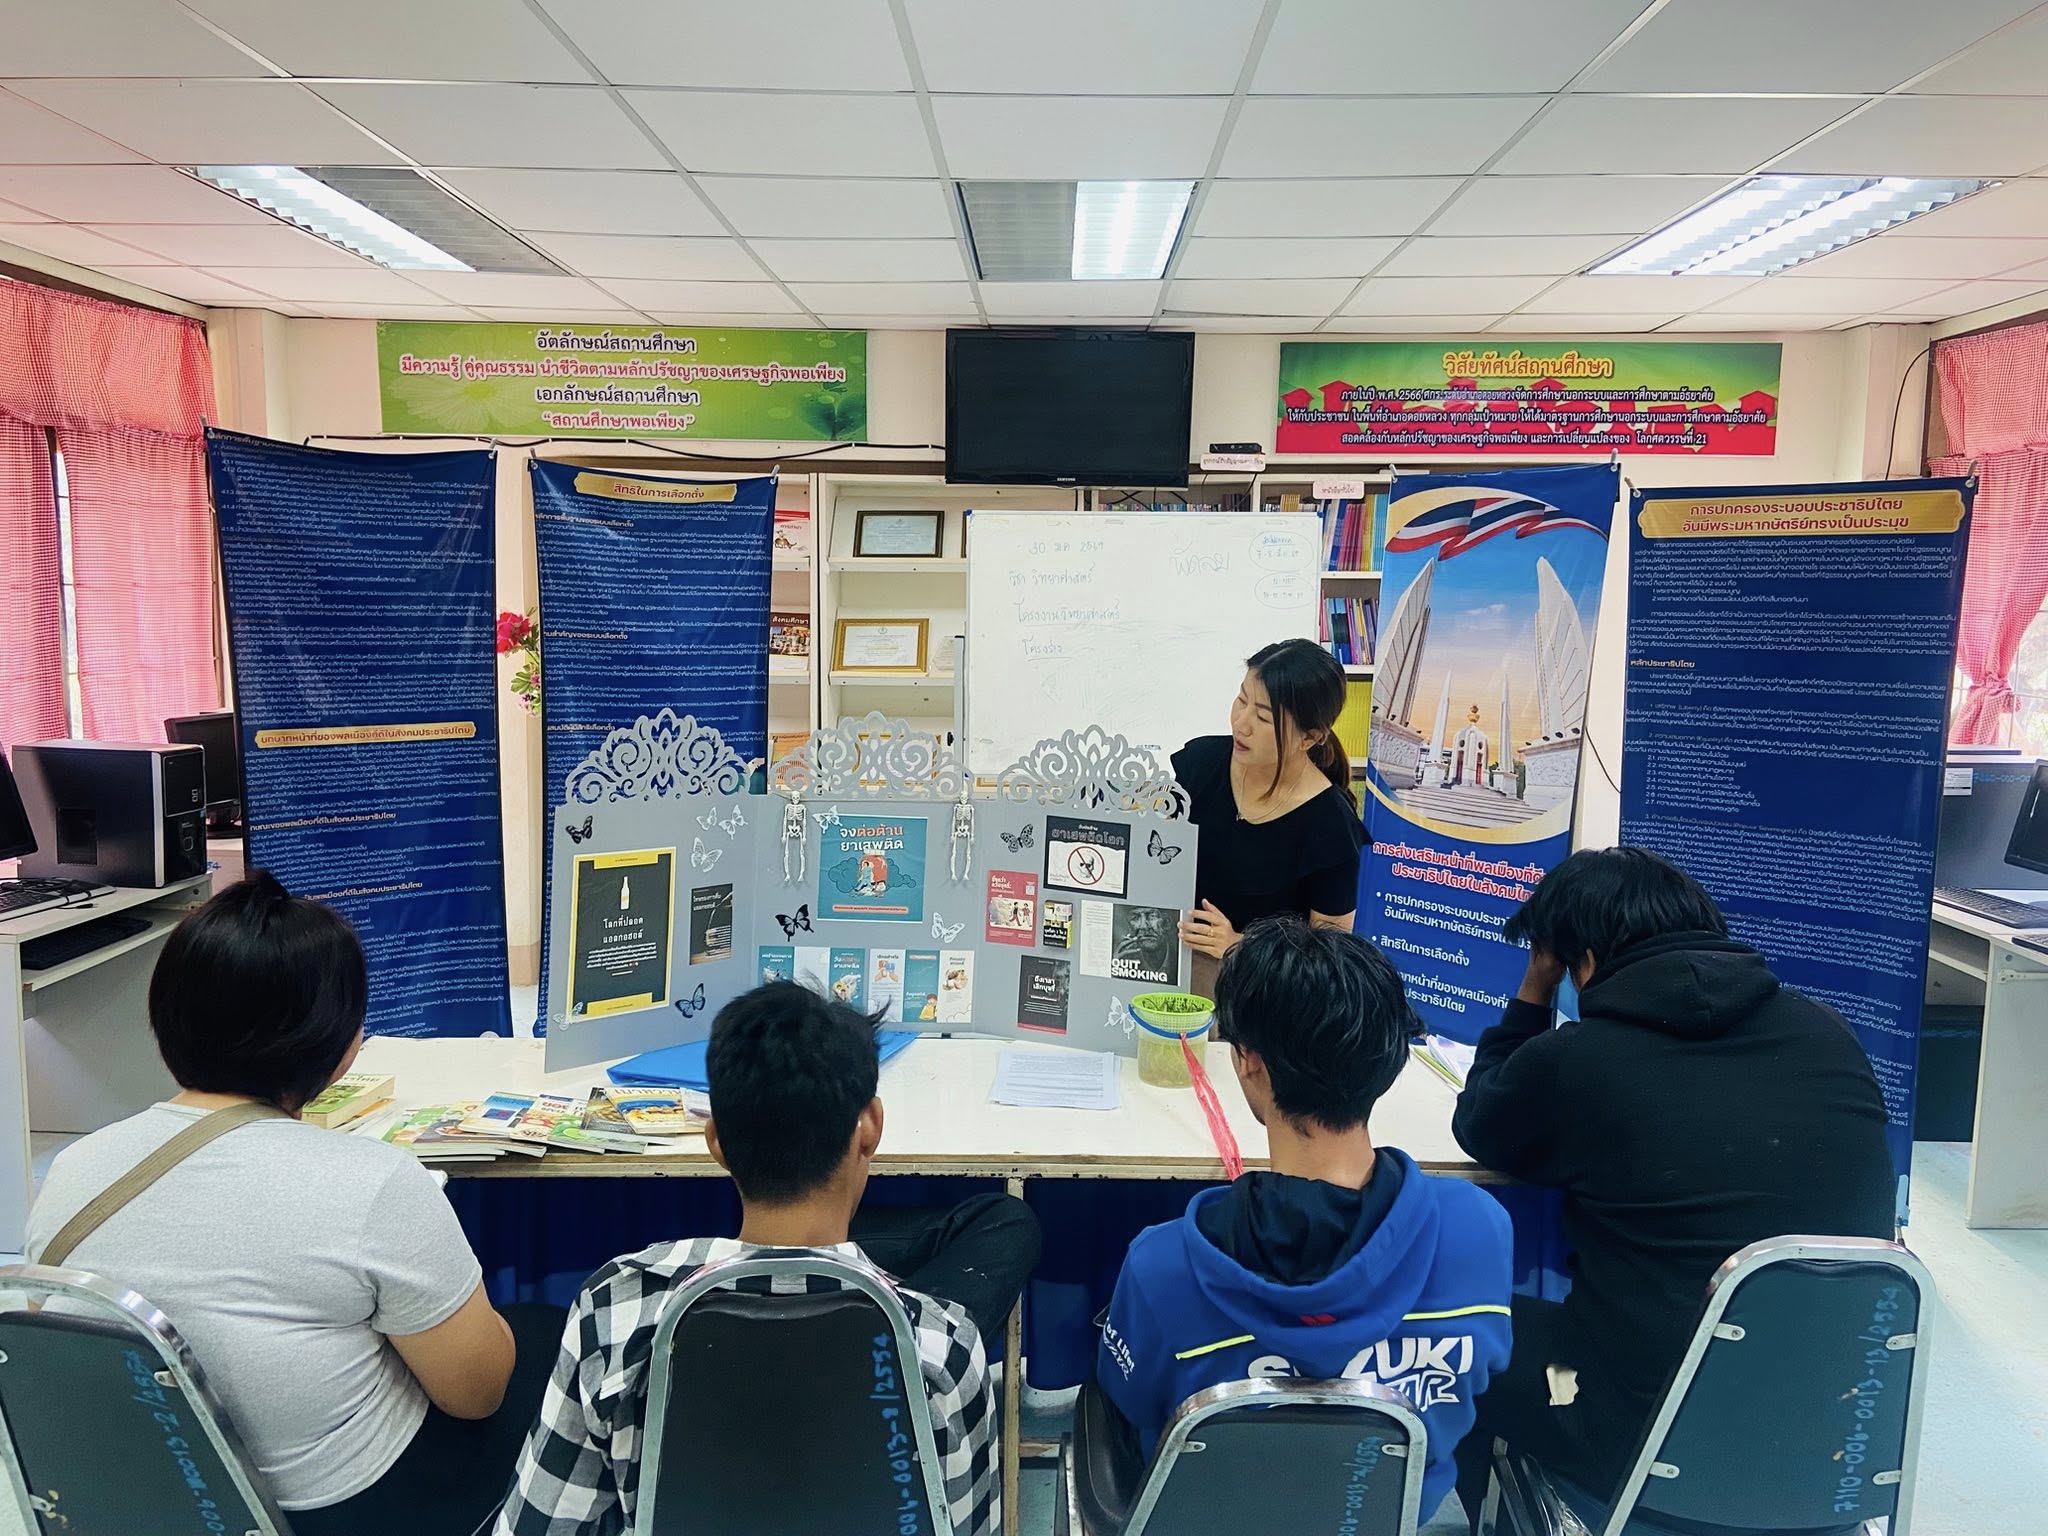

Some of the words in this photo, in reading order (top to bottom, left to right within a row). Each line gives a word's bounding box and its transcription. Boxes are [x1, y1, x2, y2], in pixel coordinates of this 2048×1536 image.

[536, 331, 697, 353] อัตลักษณ์สถานศึกษา
[401, 356, 459, 377] มีความรู้
[464, 357, 536, 378] คู่คุณธรรม
[540, 360, 845, 384] นำชีวิตตามหลักปรัชญาของเศรษฐกิจพอเพียง
[1442, 350, 1613, 378] วิสัยทัศน์สถานศึกษา
[536, 385, 700, 406] เอกลักษณ์สถานศึกษา
[1341, 387, 1374, 401] ภายในปี
[1378, 389, 1396, 401] พ.ศ.
[1400, 389, 1422, 400] 2566
[1287, 410, 1349, 424] ให้กับประชาชน
[1352, 407, 1447, 423] ในพื้นที่อำเภอดอยหลวง
[1450, 408, 1517, 426] ทุกกลุ่มเป้าหมาย
[1341, 431, 1528, 447] สอดคล้องกับหลักปรัชญาของเศรษฐกิจพอเพียง
[1530, 431, 1631, 446] และการเปลี่ยนแปลงของ
[1695, 434, 1708, 444] 21
[613, 483, 705, 499] สิทธิในการเลือกตั้ง
[1690, 497, 1903, 516] การปกครองระบอบประชาธิปไตย
[1682, 515, 1909, 533] อันมีพระมหากษัตริย์ทรงเป็นประมุข
[1028, 542, 1046, 555] 30
[1032, 561, 1096, 585] วิทยาศาสตร์
[840, 823, 904, 838] จงต่อต้าน
[1051, 828, 1125, 846] ยาเสพติดโลก
[840, 838, 904, 852] ยาเสพติด
[602, 914, 644, 929] โลกที่ปลอด
[602, 929, 644, 944] แอลกอฮอล์
[1380, 934, 1470, 967] สิทธิในการเลือกตั้ง
[1111, 958, 1141, 970] QUIT
[1111, 967, 1168, 982] SMOKING
[1247, 1335, 1474, 1381] SZUKI
